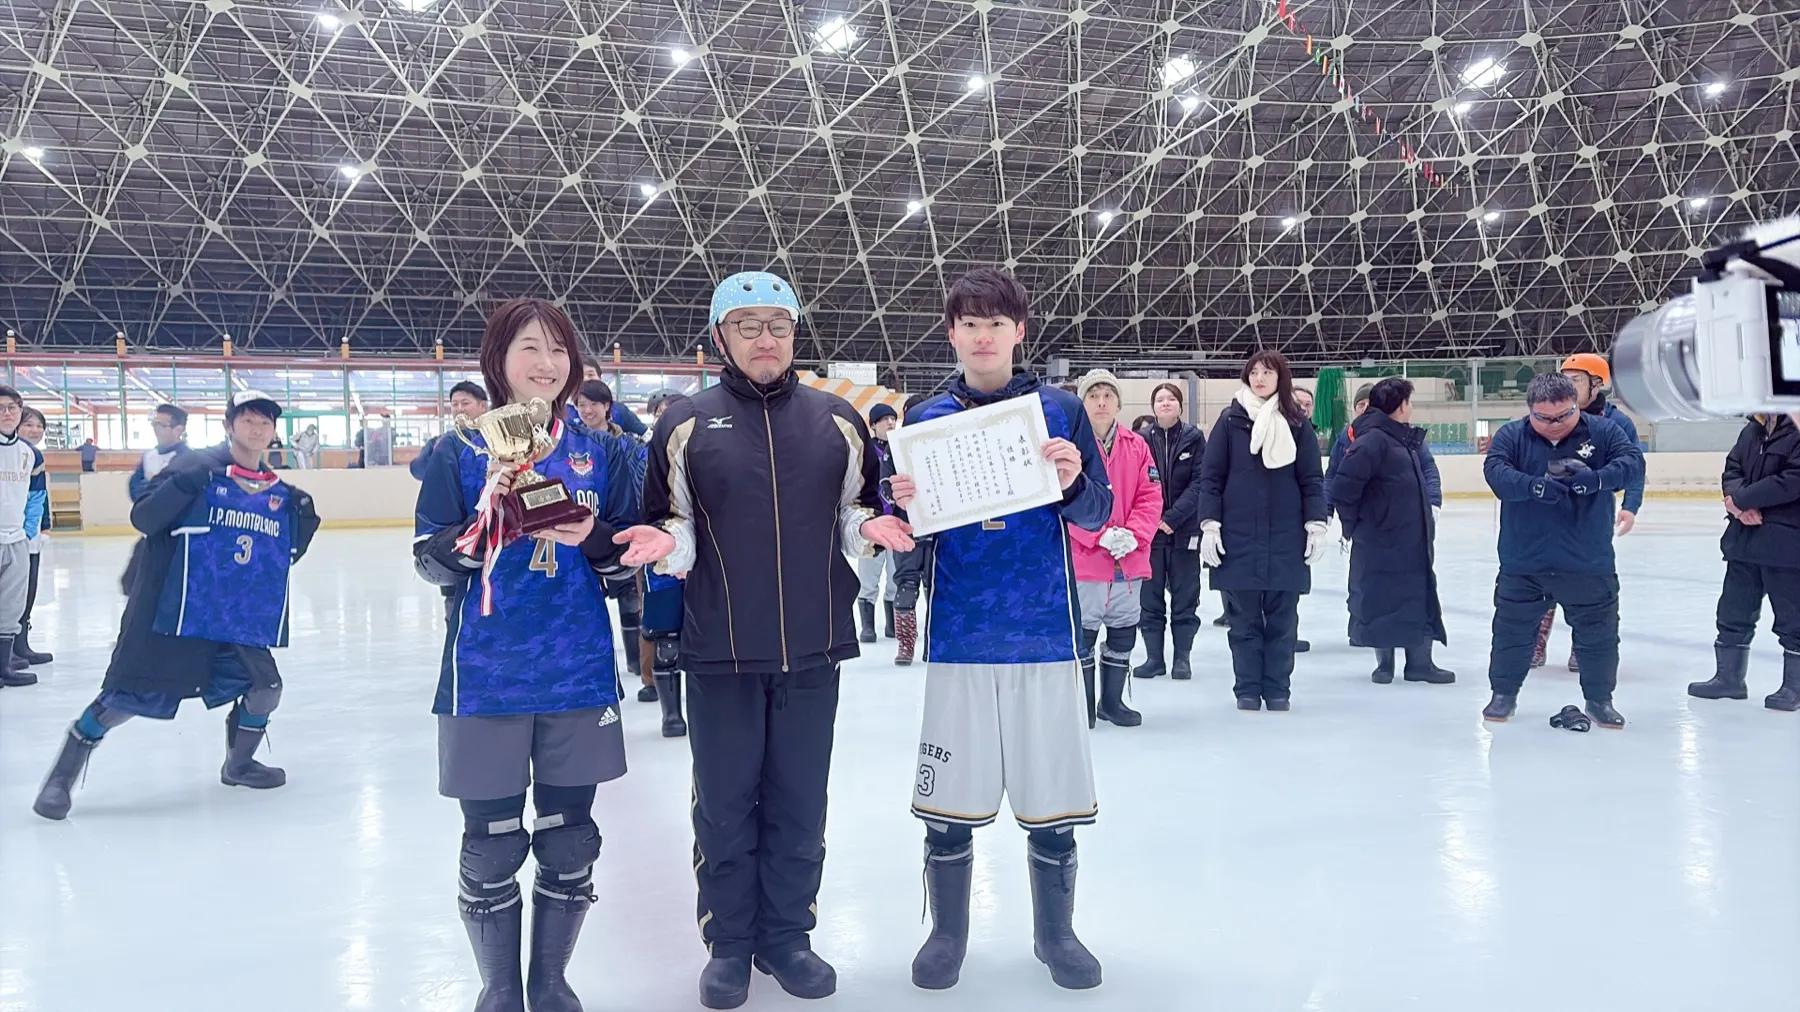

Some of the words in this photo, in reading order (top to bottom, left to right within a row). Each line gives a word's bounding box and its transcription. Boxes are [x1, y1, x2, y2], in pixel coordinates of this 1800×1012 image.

[1018, 434, 1033, 467] 表彰状
[234, 534, 253, 565] 3
[528, 538, 558, 578] 4
[598, 714, 619, 727] adidas
[917, 763, 936, 797] 3
